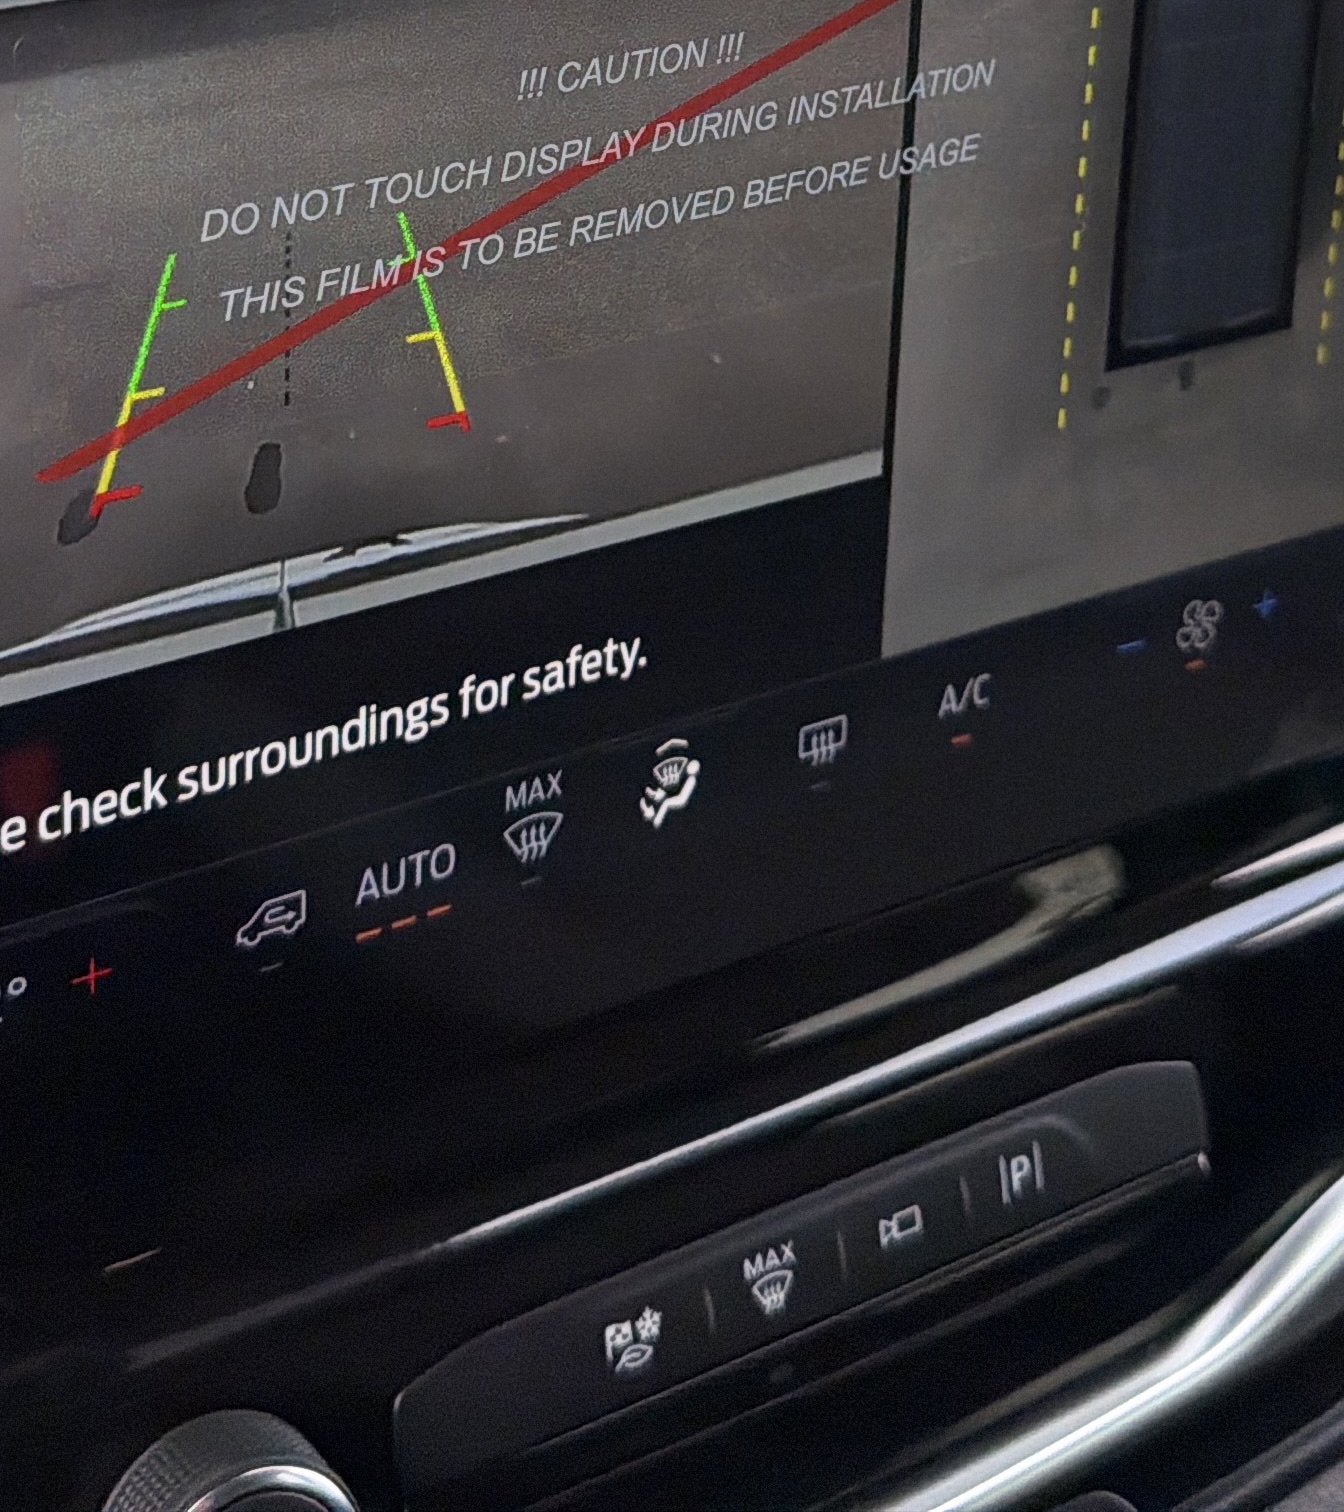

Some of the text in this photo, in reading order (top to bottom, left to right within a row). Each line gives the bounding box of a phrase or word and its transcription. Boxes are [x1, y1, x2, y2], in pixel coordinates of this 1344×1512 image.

[516, 31, 745, 101] !!! CAUTION !!!
[200, 58, 997, 243] DO NOT TOUCH DISPLAY DURING INSTALLATION
[219, 133, 980, 322] THIS FILM IS TO BE REMOVED BEFORE USAGE
[938, 672, 992, 719] A/C
[36, 769, 169, 843] check
[176, 693, 450, 804] surroundings
[458, 670, 522, 723] for
[520, 635, 649, 702] safety.
[502, 769, 564, 814] MAX
[354, 841, 457, 908] AUTO
[743, 1239, 797, 1282] MAX
